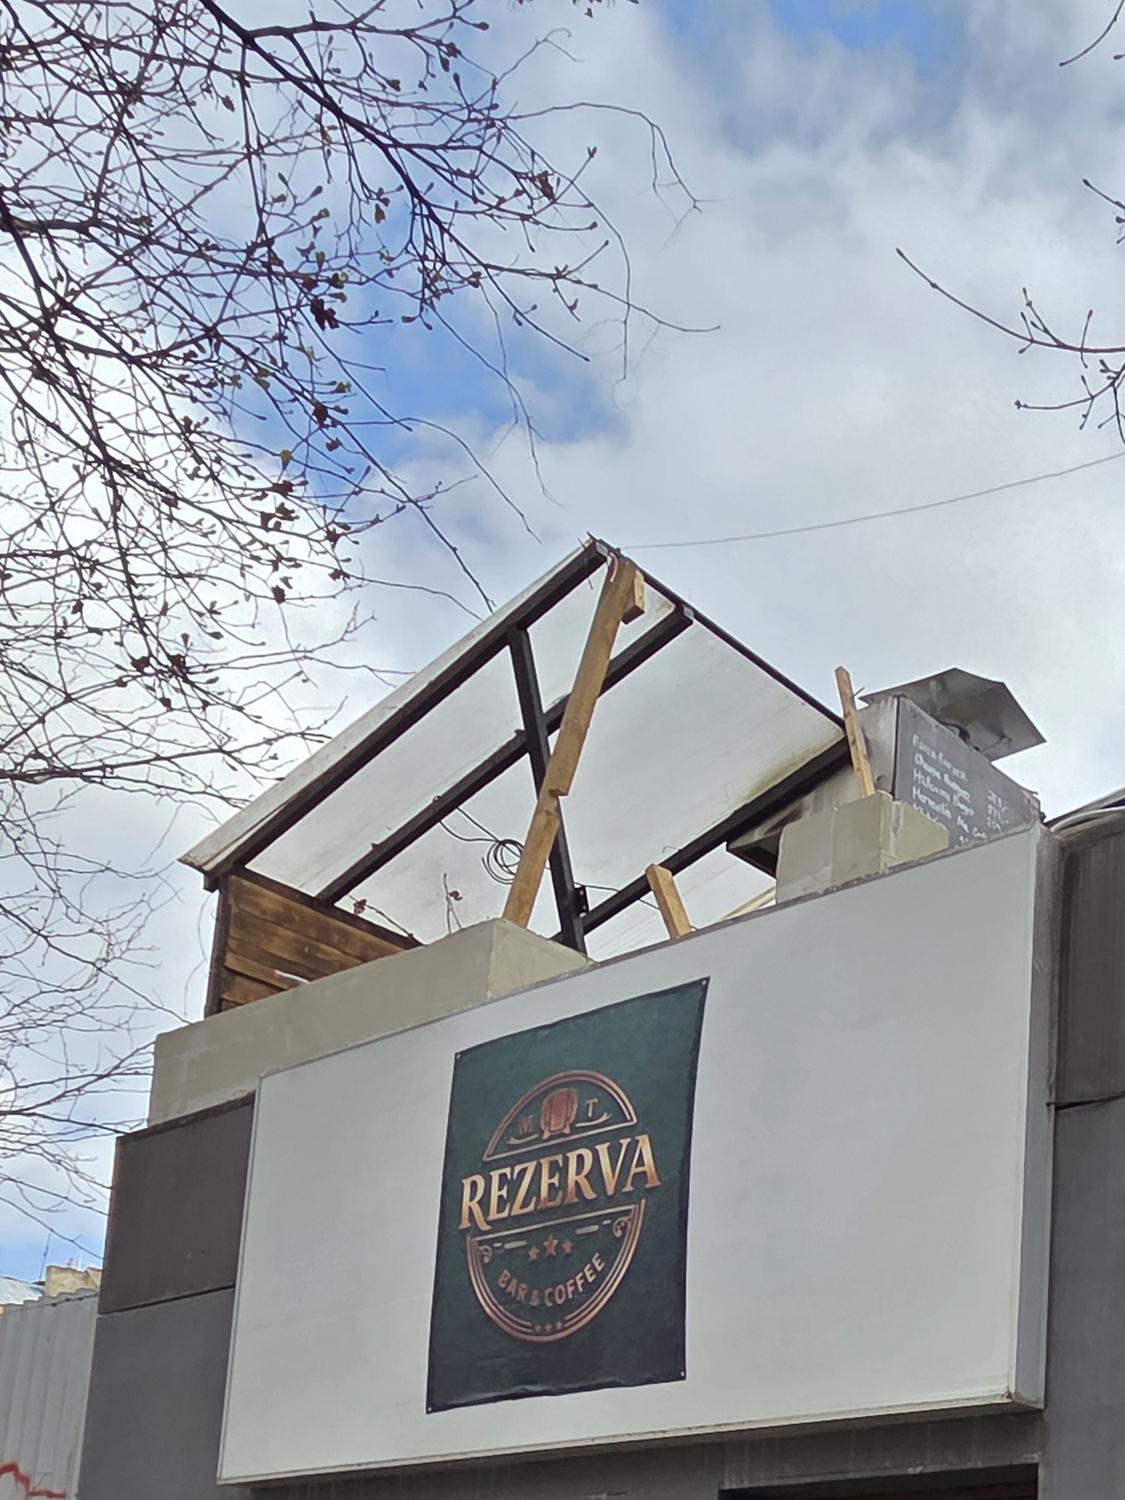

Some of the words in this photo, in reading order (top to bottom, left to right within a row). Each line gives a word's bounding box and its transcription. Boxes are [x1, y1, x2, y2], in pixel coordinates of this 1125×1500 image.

[584, 1097, 599, 1118] T
[458, 1134, 662, 1231] REZERVA
[497, 1267, 528, 1302] BAR
[529, 1286, 541, 1307] &
[545, 1252, 606, 1306] COFFEE
